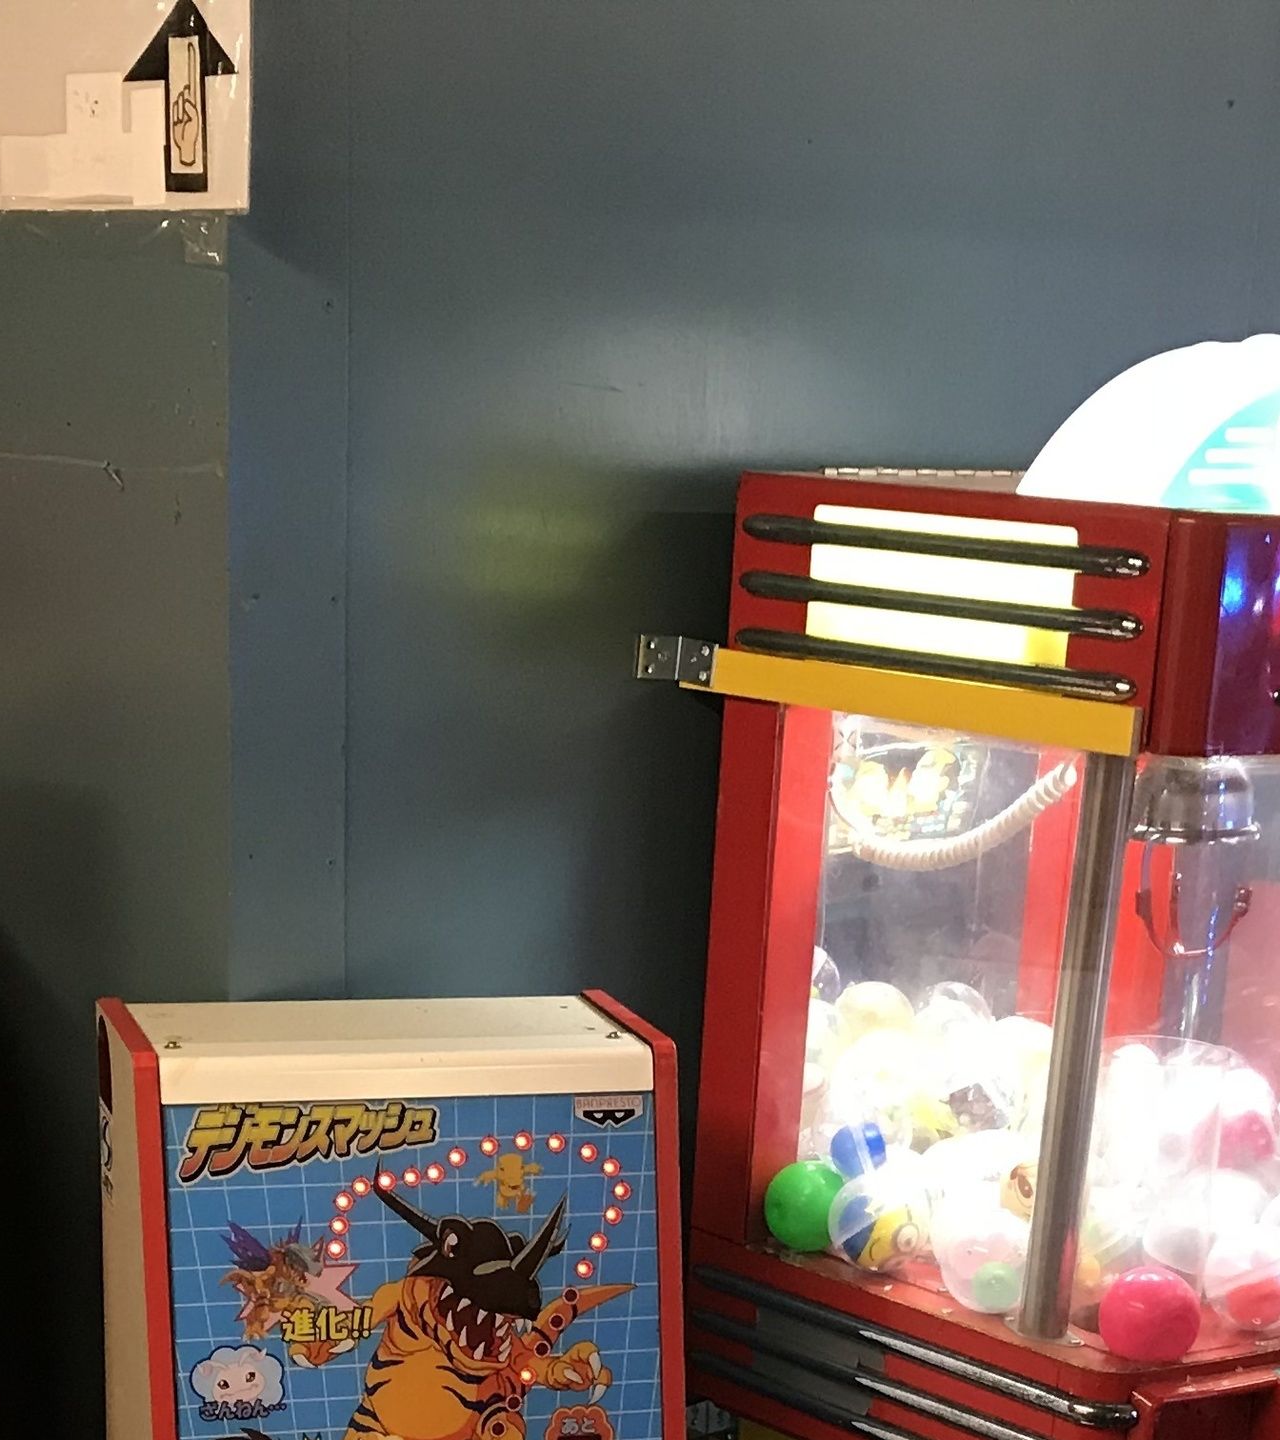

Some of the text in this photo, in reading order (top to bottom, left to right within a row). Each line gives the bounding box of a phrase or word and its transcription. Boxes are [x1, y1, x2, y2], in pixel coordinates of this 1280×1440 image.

[179, 1102, 438, 1183] デジモンスマッシュ
[561, 1418, 596, 1435] あと
